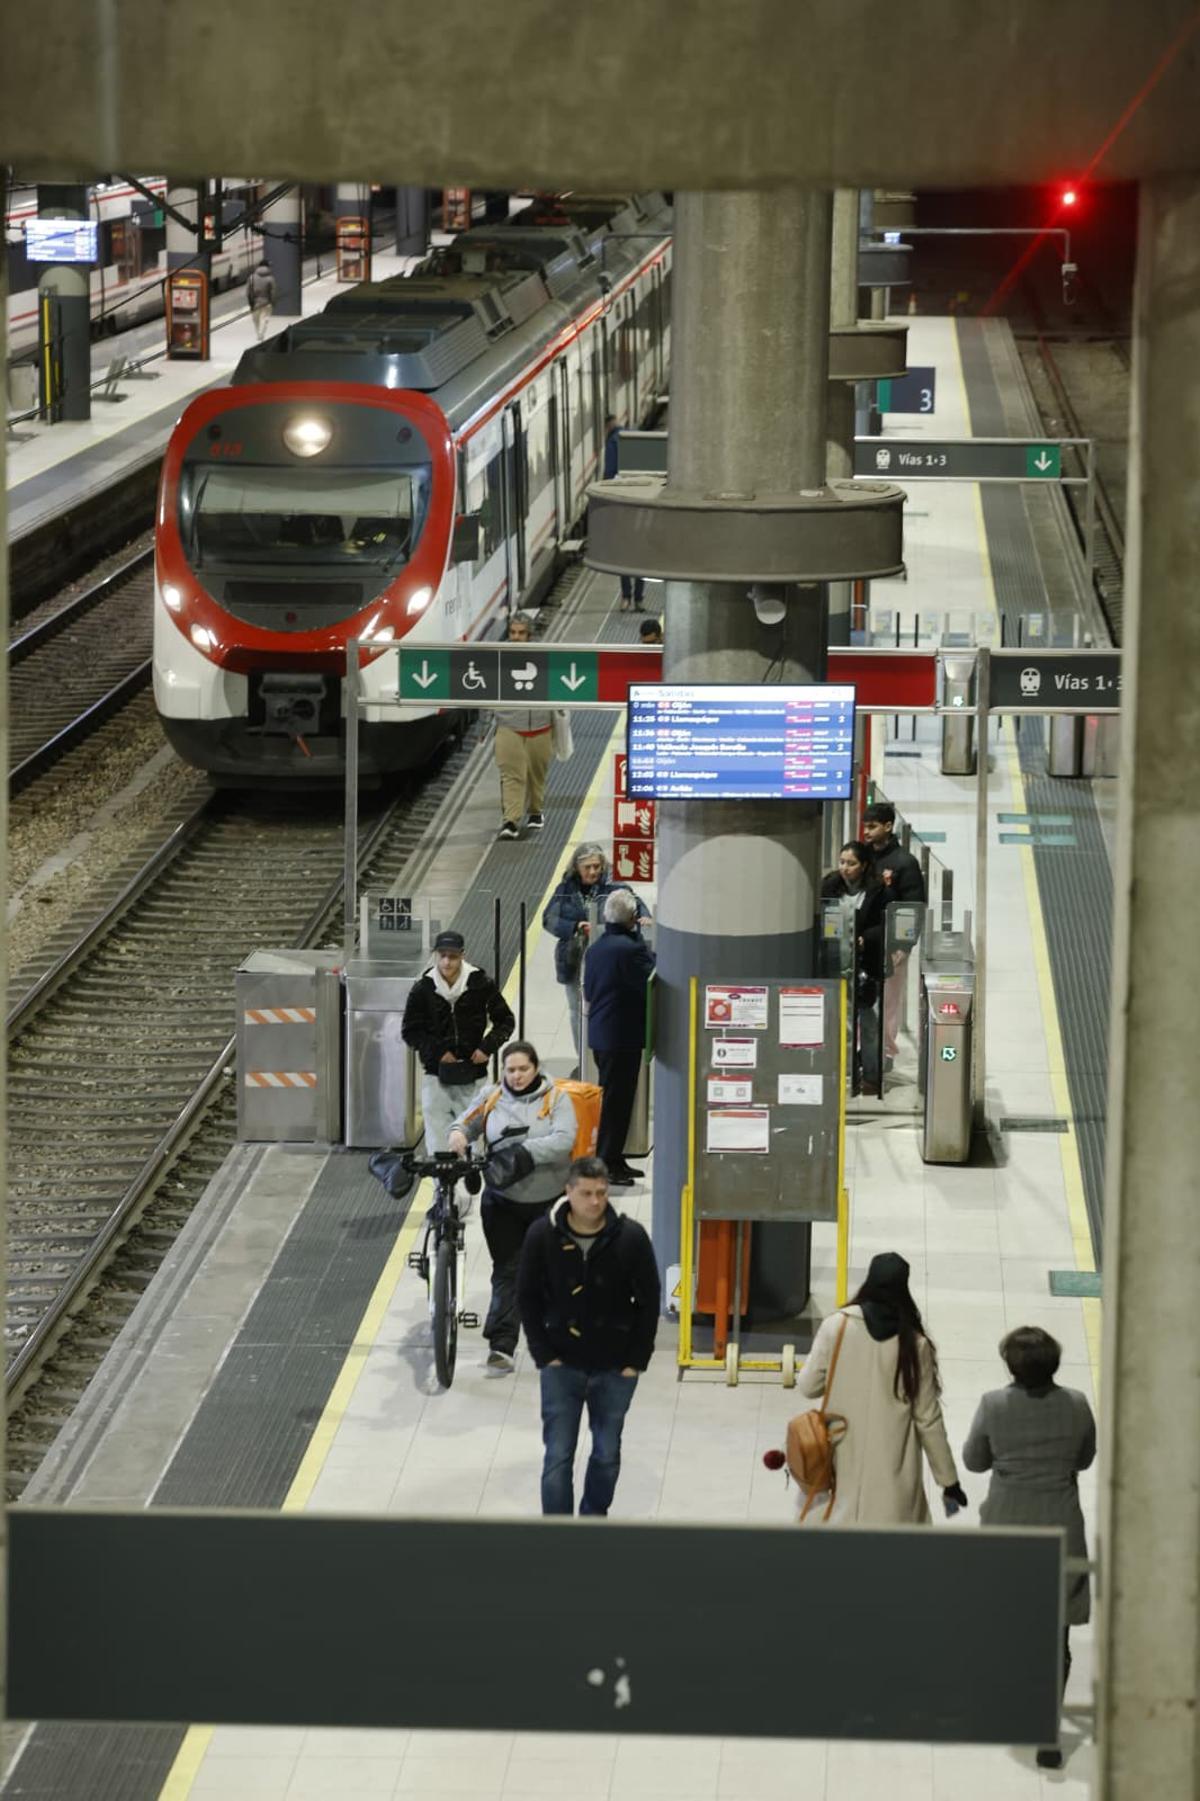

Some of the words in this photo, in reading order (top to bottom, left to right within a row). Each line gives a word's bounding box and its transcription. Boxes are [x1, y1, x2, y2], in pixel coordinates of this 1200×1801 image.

[920, 388, 932, 412] 3
[899, 453, 922, 466] Vías
[1054, 673, 1089, 690] Vías
